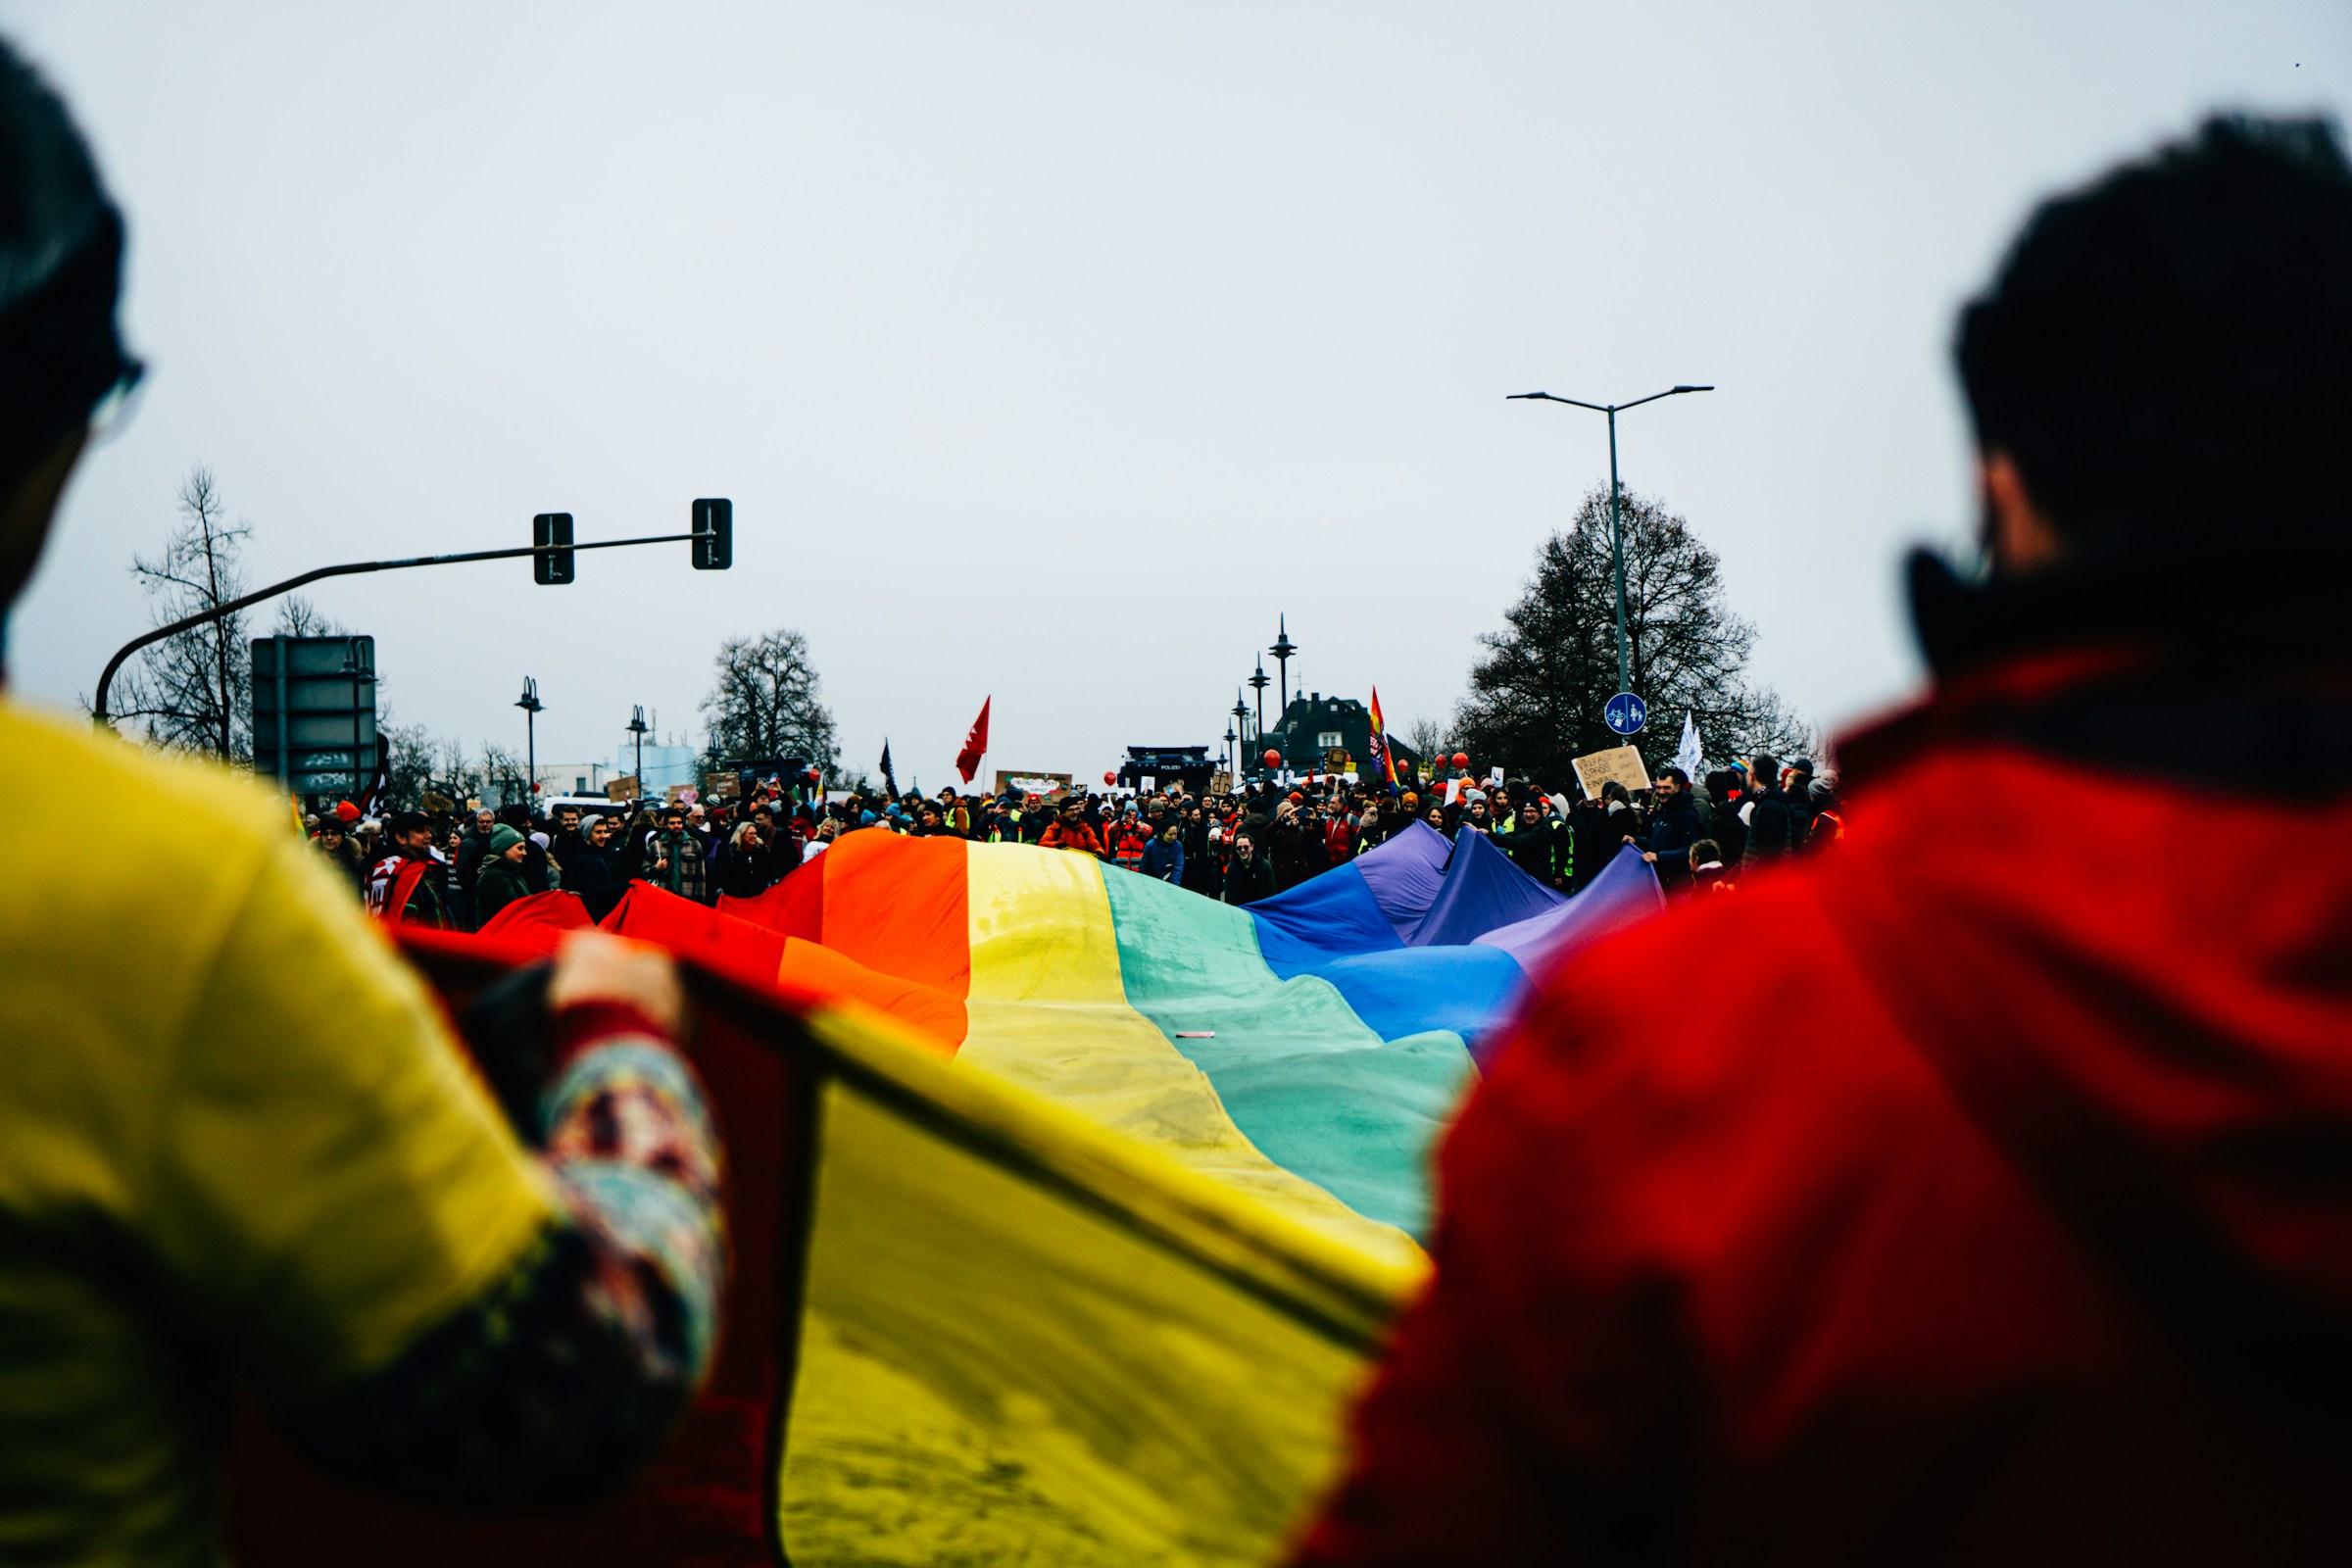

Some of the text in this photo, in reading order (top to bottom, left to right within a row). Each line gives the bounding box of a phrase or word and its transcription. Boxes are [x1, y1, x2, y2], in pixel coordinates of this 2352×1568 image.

[1577, 753, 1612, 770] VIELFALT
[1584, 762, 1610, 779] SPASS
[1586, 772, 1619, 789] EINFALT
